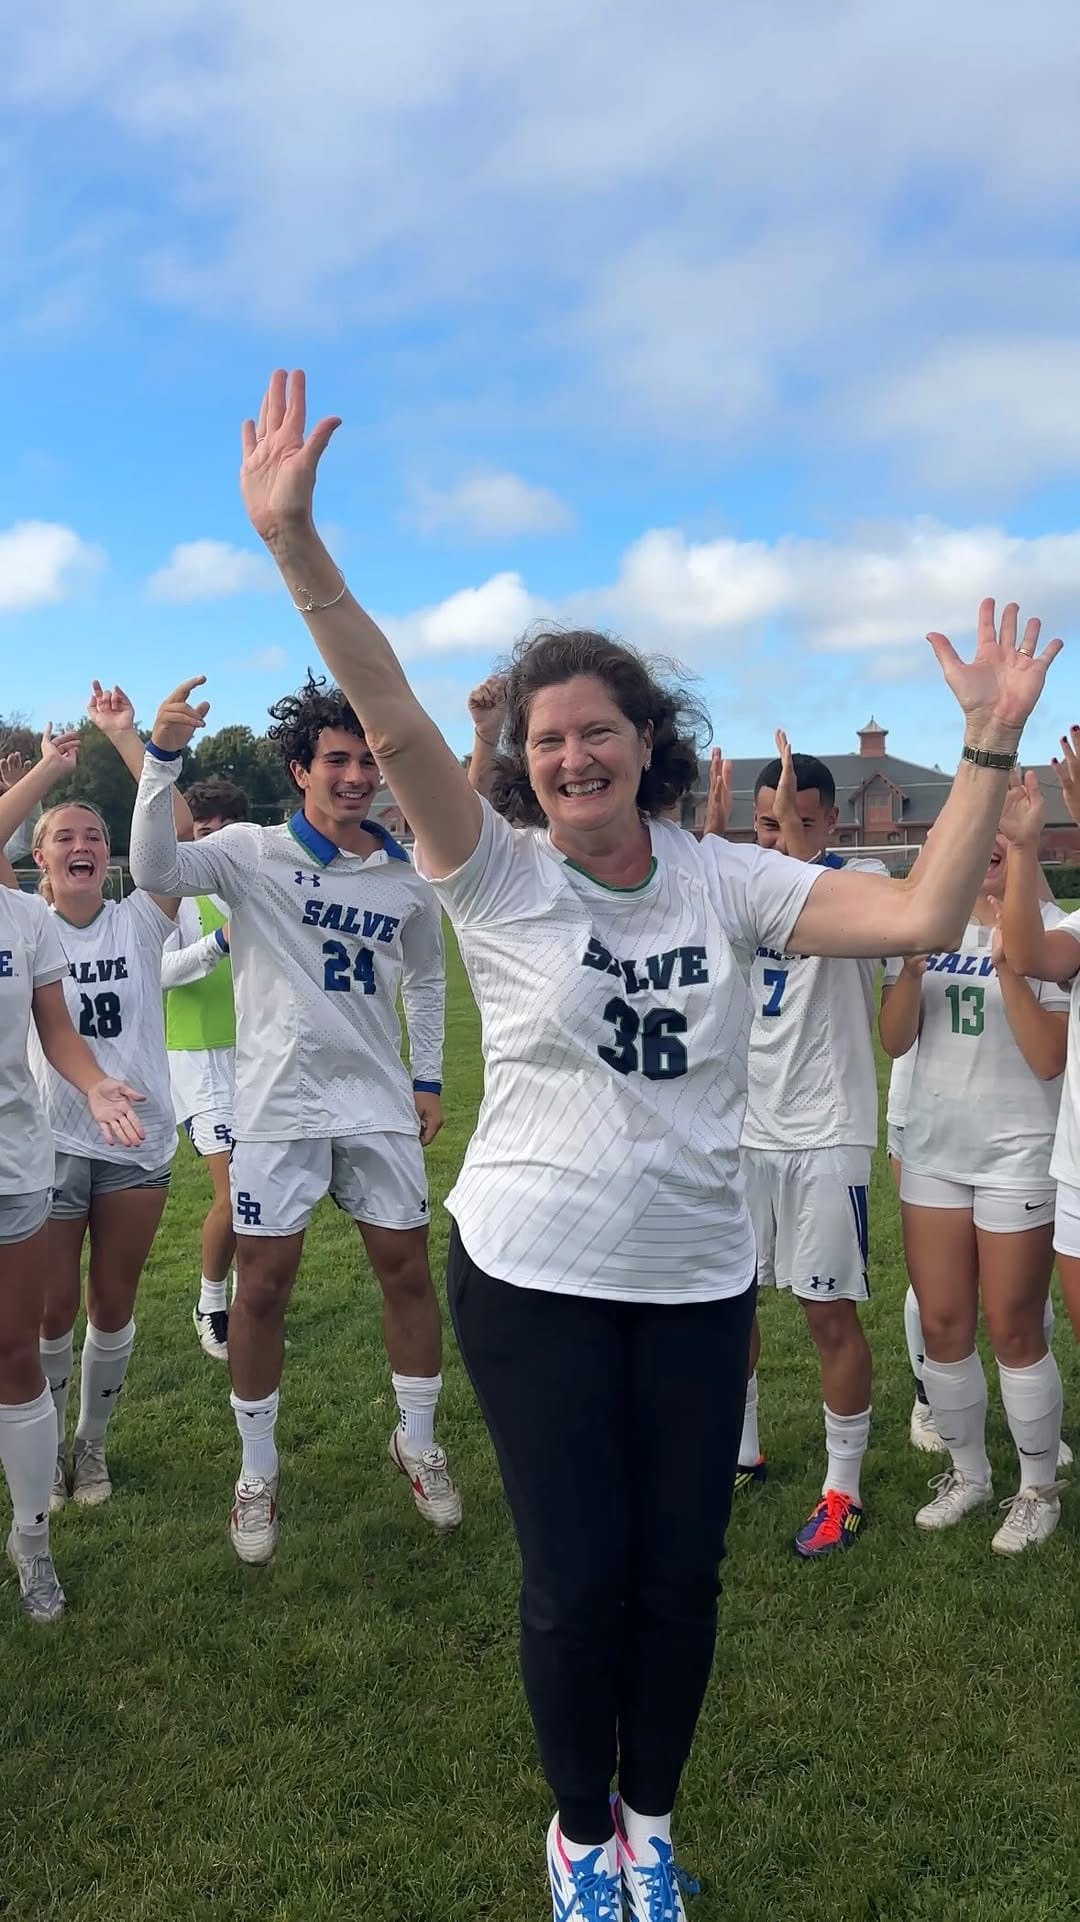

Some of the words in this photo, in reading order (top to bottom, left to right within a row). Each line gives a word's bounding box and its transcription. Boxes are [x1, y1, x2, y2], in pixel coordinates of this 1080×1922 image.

[302, 899, 400, 943] SALVE
[322, 939, 376, 995] 24
[80, 991, 122, 1039] 28
[762, 968, 789, 1017] 7
[945, 984, 985, 1036] 13
[597, 996, 688, 1080] 36
